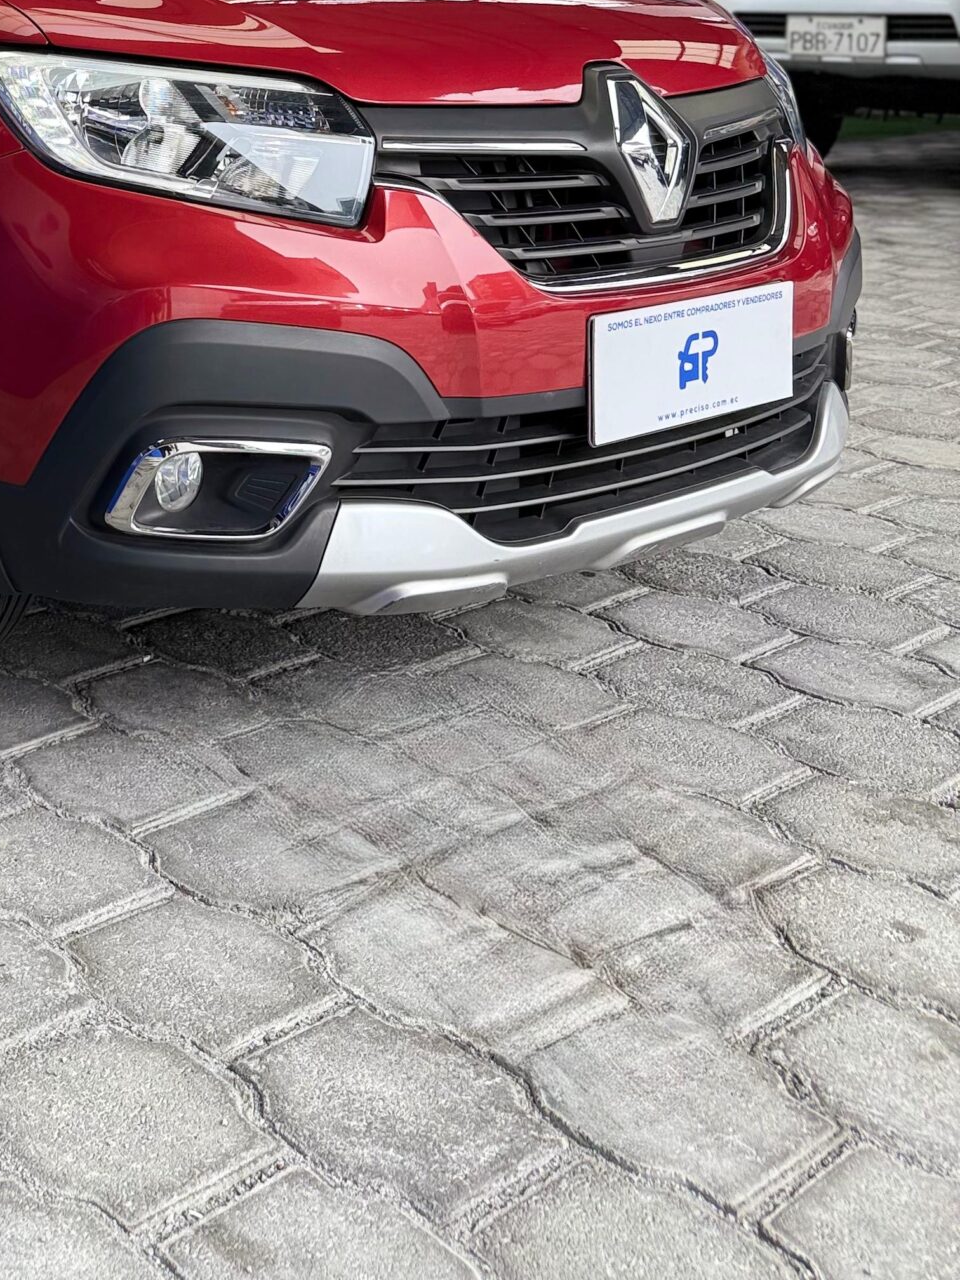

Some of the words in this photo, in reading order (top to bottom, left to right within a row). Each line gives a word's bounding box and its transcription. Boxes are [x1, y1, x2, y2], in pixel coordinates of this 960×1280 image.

[607, 319, 633, 332] SOMOS
[634, 318, 643, 327] EL
[644, 313, 663, 324] NEXO
[664, 309, 686, 321] ENTRE
[686, 300, 736, 317] COMPRADORES
[736, 299, 741, 307] Y
[742, 290, 783, 306] VENDEDORES
[657, 396, 739, 421] www.preciso.com.ec
